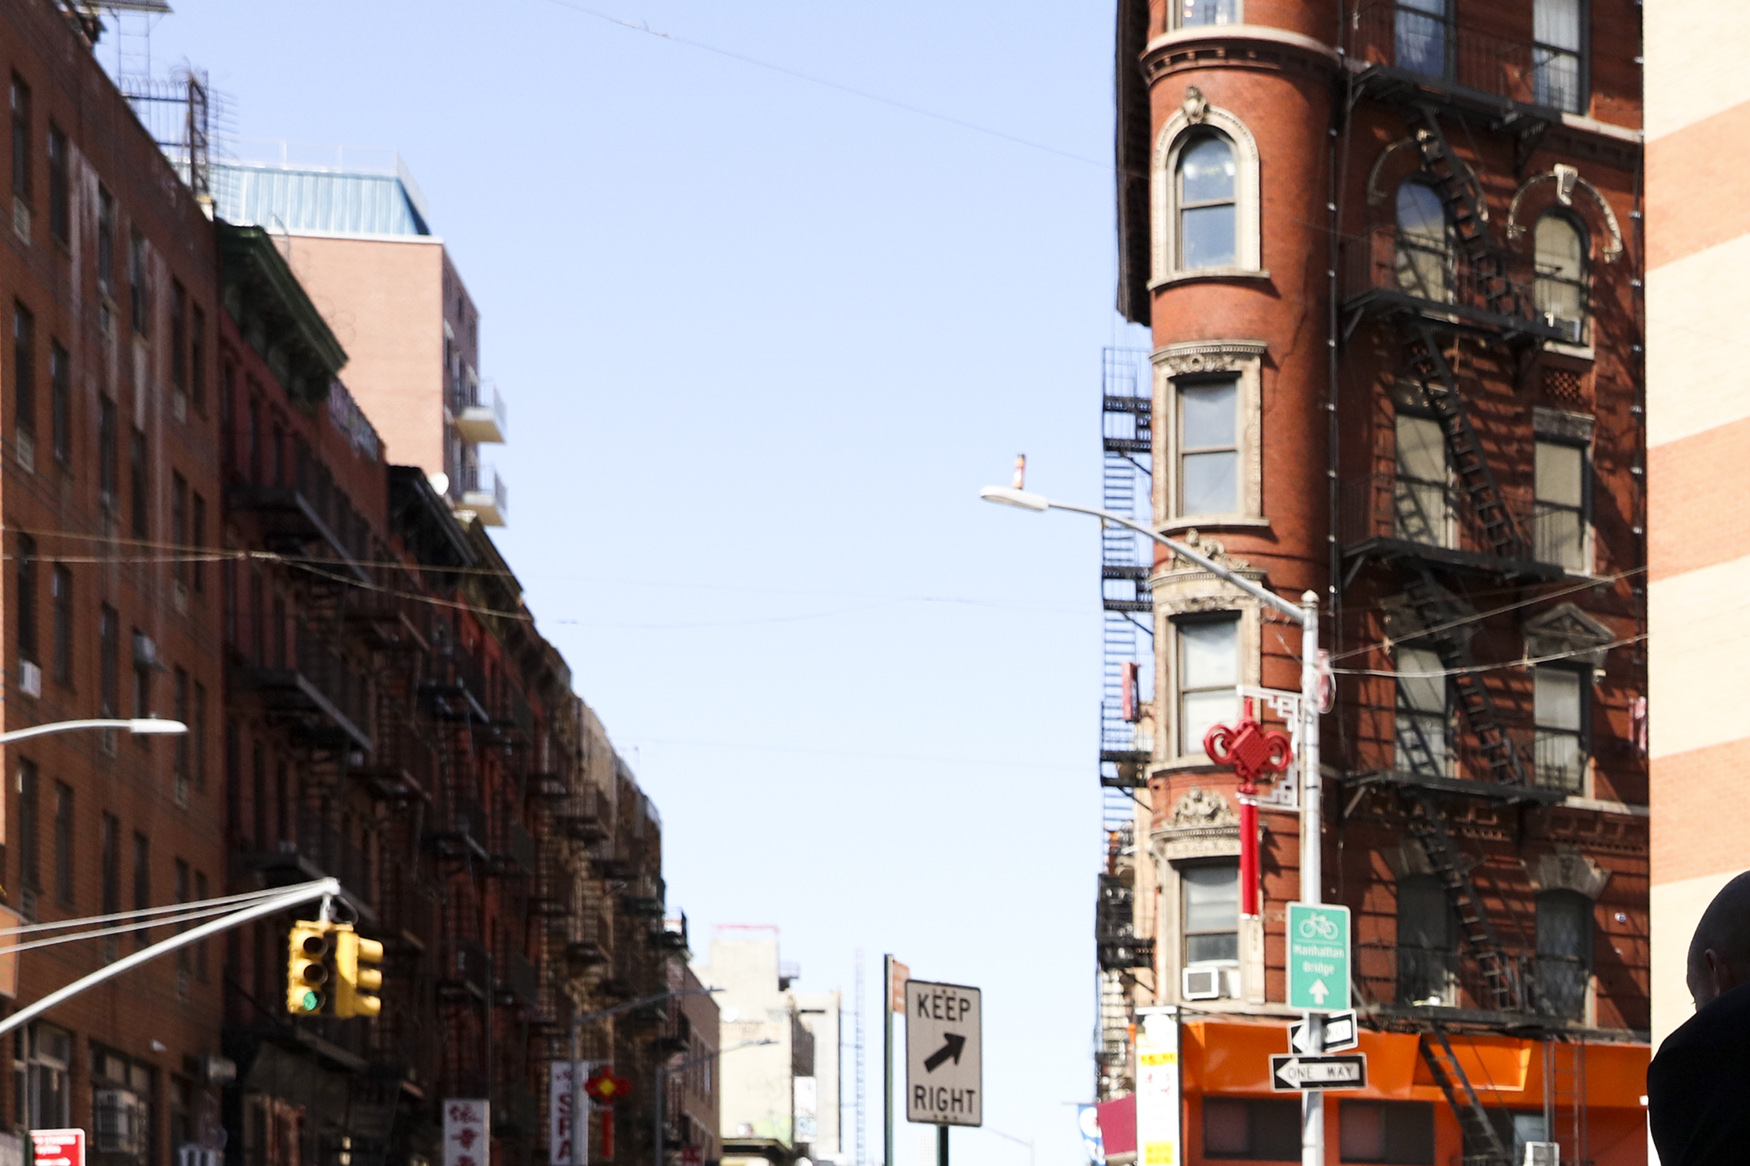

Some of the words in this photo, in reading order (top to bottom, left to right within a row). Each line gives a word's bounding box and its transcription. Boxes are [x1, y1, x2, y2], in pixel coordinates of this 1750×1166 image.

[1293, 944, 1345, 959] Manhattan
[1302, 960, 1335, 977] Bridge
[916, 993, 971, 1022] KEEP
[1288, 1066, 1313, 1081] ONE
[1327, 1064, 1355, 1079] WAY
[913, 1084, 976, 1114] RIGHT
